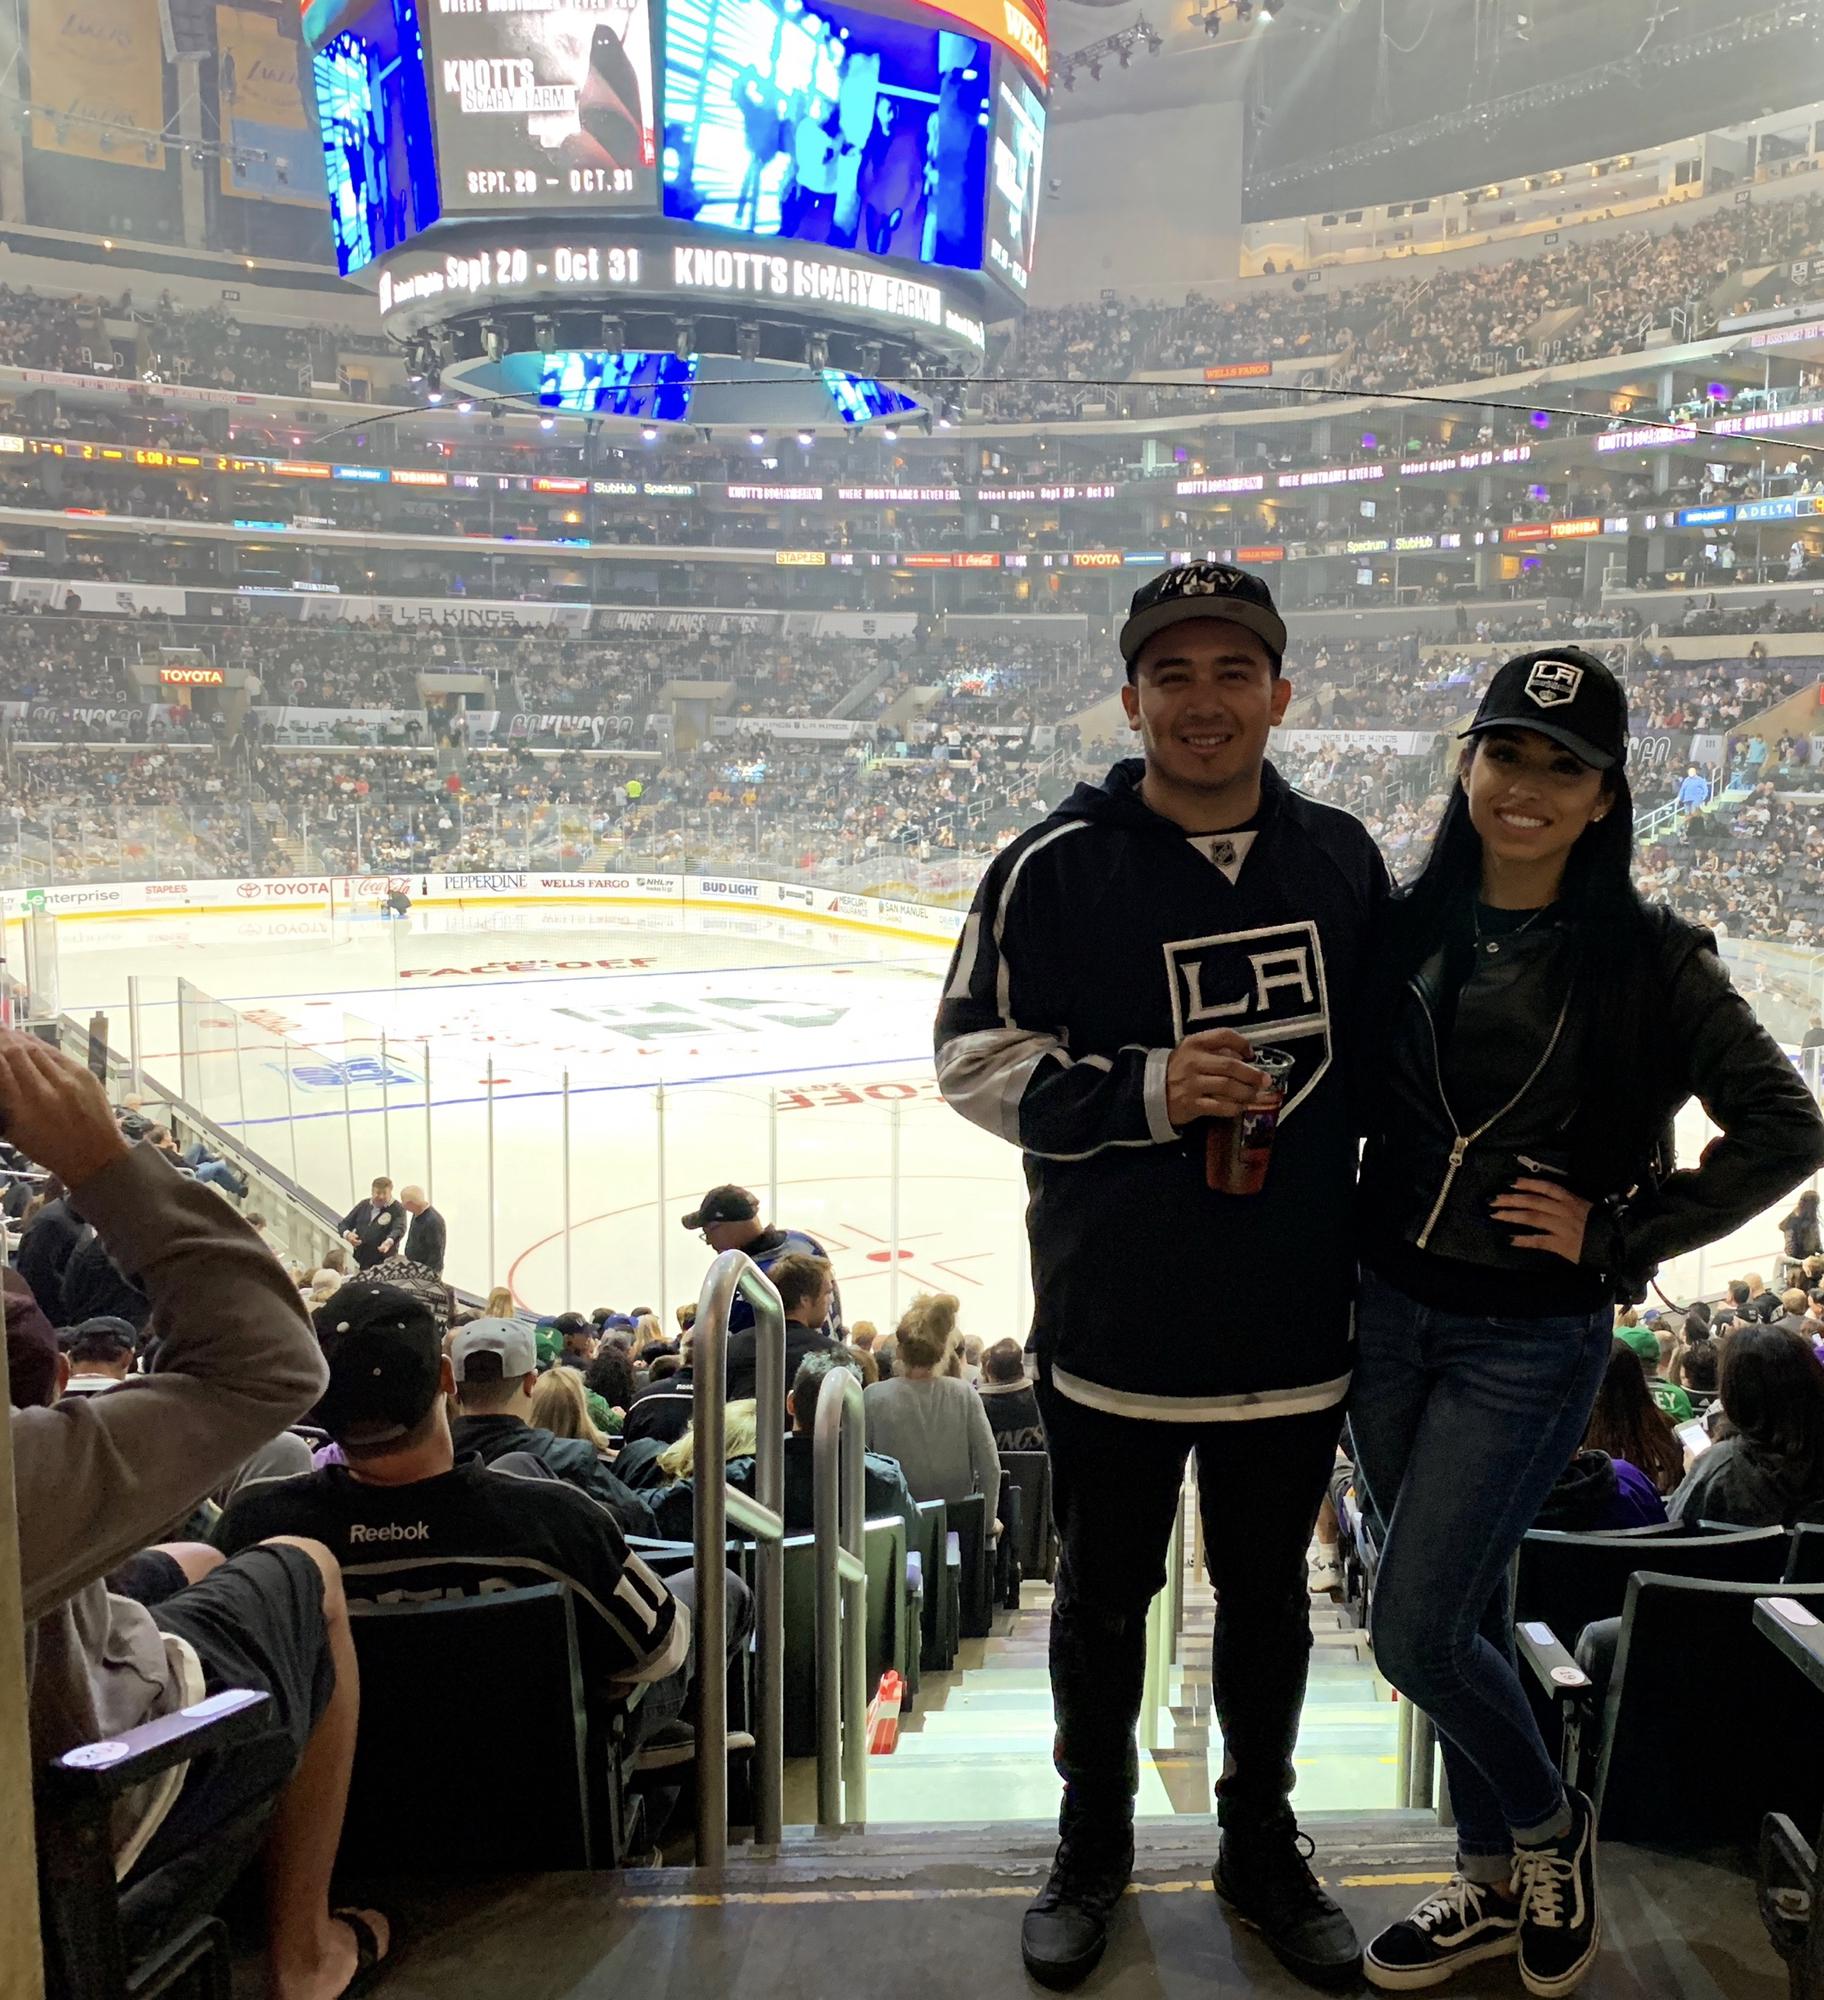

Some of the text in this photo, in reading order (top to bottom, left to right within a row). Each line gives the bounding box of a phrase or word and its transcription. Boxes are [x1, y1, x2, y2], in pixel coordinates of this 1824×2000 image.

[465, 88, 515, 111] SCARY
[468, 171, 511, 193] SEPT.
[446, 255, 491, 293] Sept
[555, 247, 599, 282] Oct
[608, 248, 639, 282] 31
[675, 247, 788, 294] KNOTT'S
[1206, 364, 1269, 379] WELLS FARGO
[393, 471, 447, 485] TOSHIBA
[838, 488, 863, 500] WHERE
[1751, 502, 1793, 518] DELTA
[1551, 519, 1598, 536] TOSHIBA
[777, 553, 824, 565] STAPLES
[1073, 554, 1121, 565] TOYOTA
[161, 669, 223, 684] TOYOTA
[145, 884, 188, 895] STAPLES
[264, 882, 329, 896] TOYOTA
[444, 874, 528, 892] PEPPERDINE
[541, 879, 630, 889] WELLS FARGO
[702, 881, 758, 897] BUD LIGHT
[885, 902, 899, 912] SAN
[900, 904, 929, 919] MANUEL
[1180, 946, 1314, 1022] LA
[350, 1520, 430, 1545] Reebok
